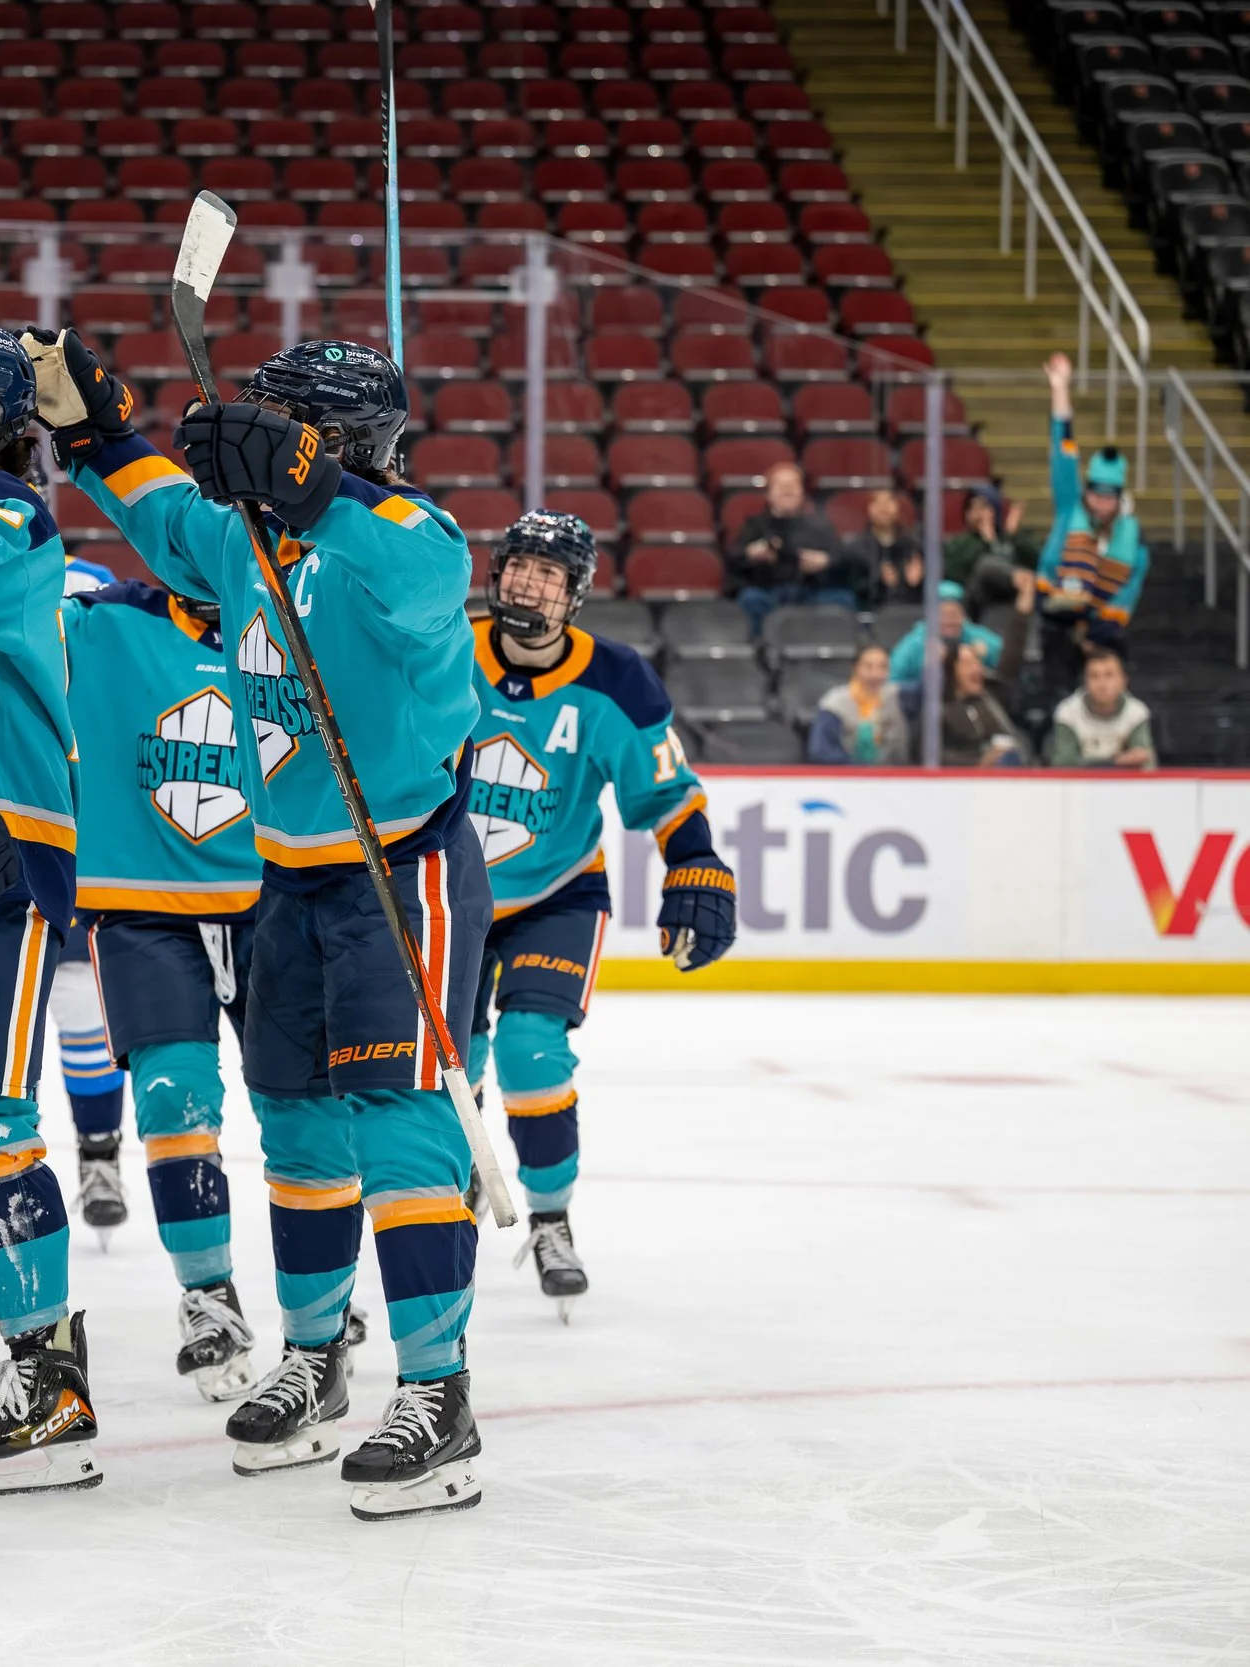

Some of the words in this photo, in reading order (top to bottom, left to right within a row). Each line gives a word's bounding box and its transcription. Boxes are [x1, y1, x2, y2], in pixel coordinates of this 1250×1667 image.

[345, 349, 375, 360] bread
[315, 383, 359, 400] BAUER
[295, 552, 321, 618] C
[195, 663, 226, 674] BAUE
[544, 704, 579, 754] A
[144, 735, 244, 791] SIREN
[468, 779, 555, 835] RENS
[512, 953, 587, 980] BAUER
[328, 1041, 416, 1069] BAUER
[29, 1397, 82, 1446] CCM
[423, 1433, 451, 1461] BAUER
